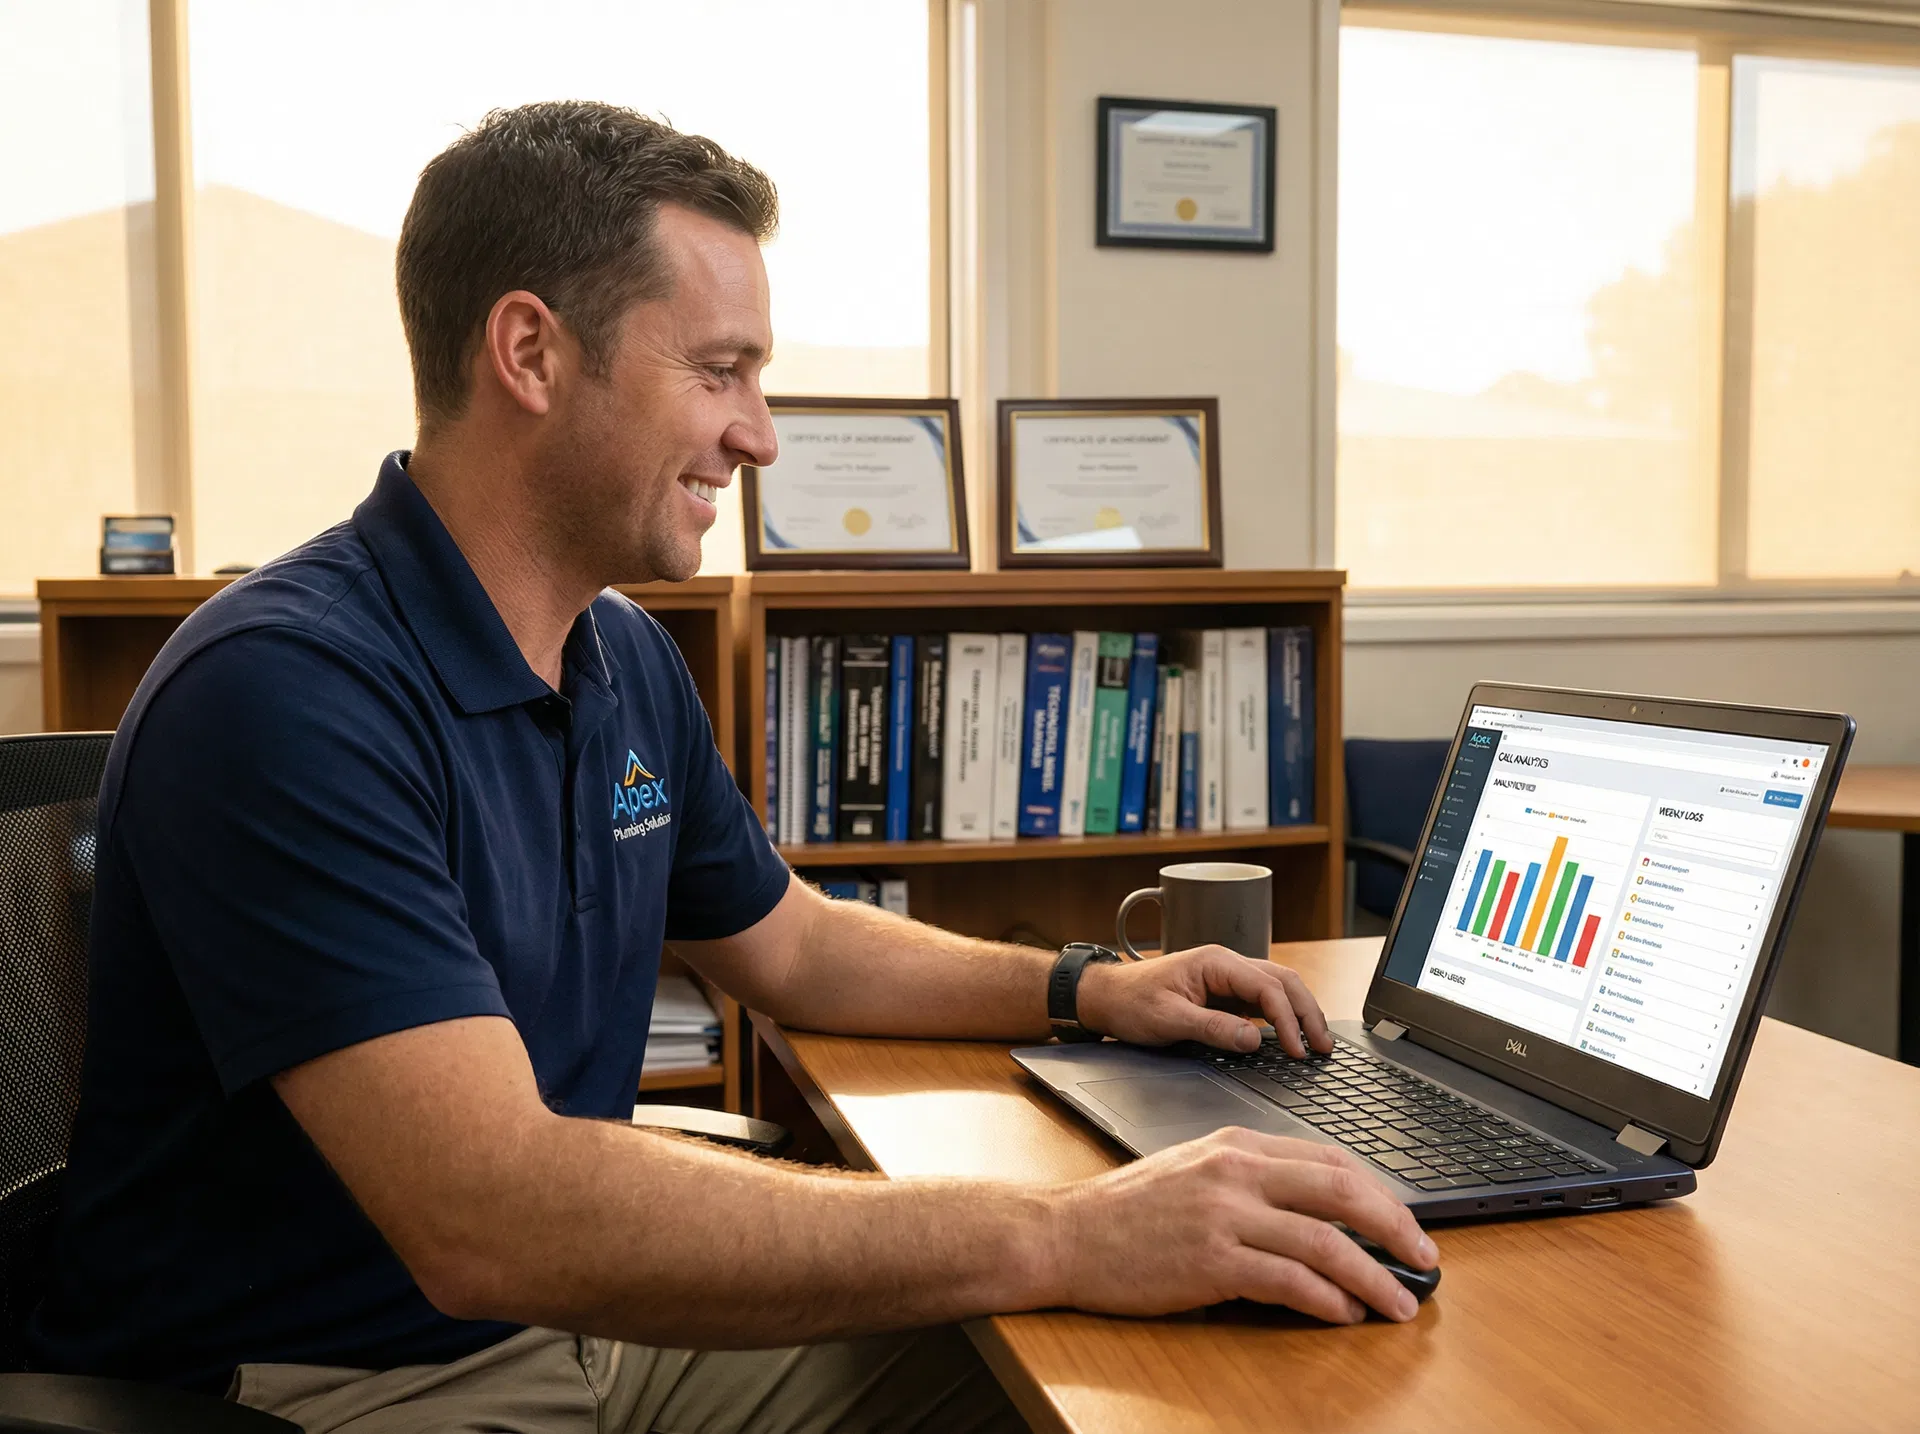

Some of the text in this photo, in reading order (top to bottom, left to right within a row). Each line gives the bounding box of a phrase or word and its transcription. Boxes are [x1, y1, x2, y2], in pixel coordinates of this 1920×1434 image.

[1498, 752, 1514, 764] CALL
[613, 778, 668, 821] Apex
[1684, 809, 1704, 823] LOGS
[613, 813, 672, 842] Plumbing Solutions
